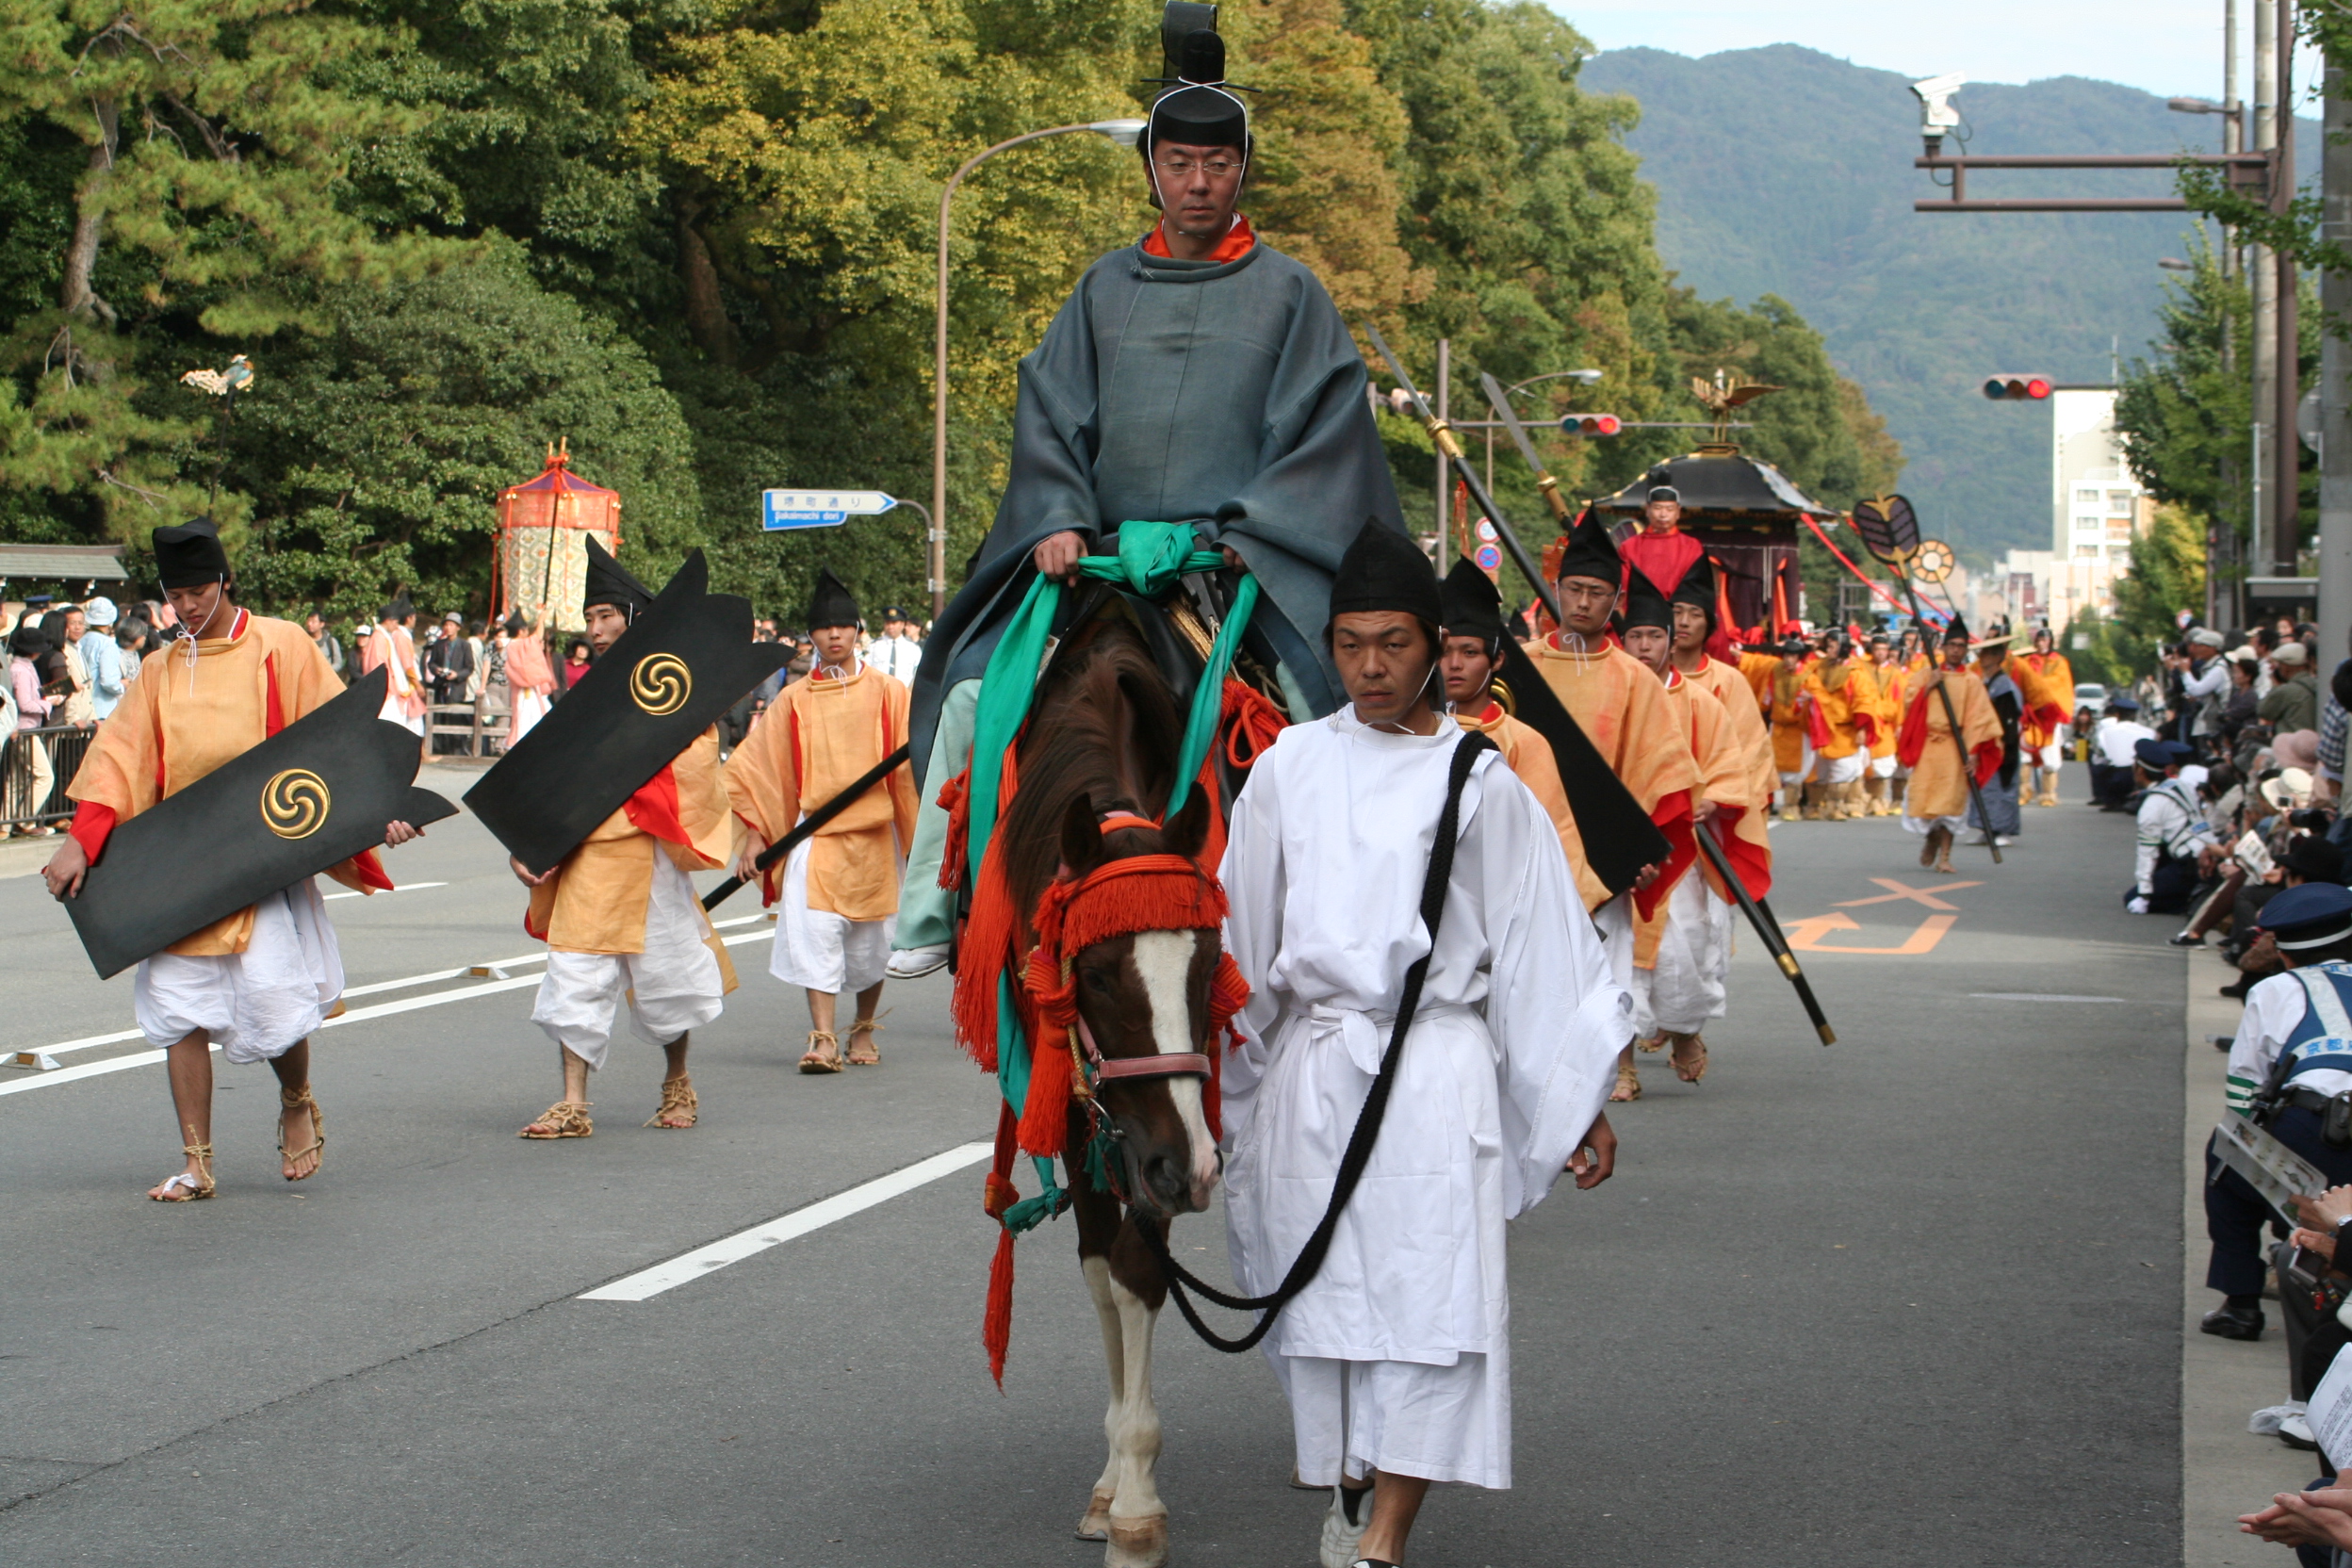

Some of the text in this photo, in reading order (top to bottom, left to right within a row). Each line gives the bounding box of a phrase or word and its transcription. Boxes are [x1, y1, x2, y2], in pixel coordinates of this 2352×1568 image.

[784, 496, 860, 508] 堺町通り
[823, 511, 840, 520] dori
[2305, 1037, 2352, 1057] 京都
